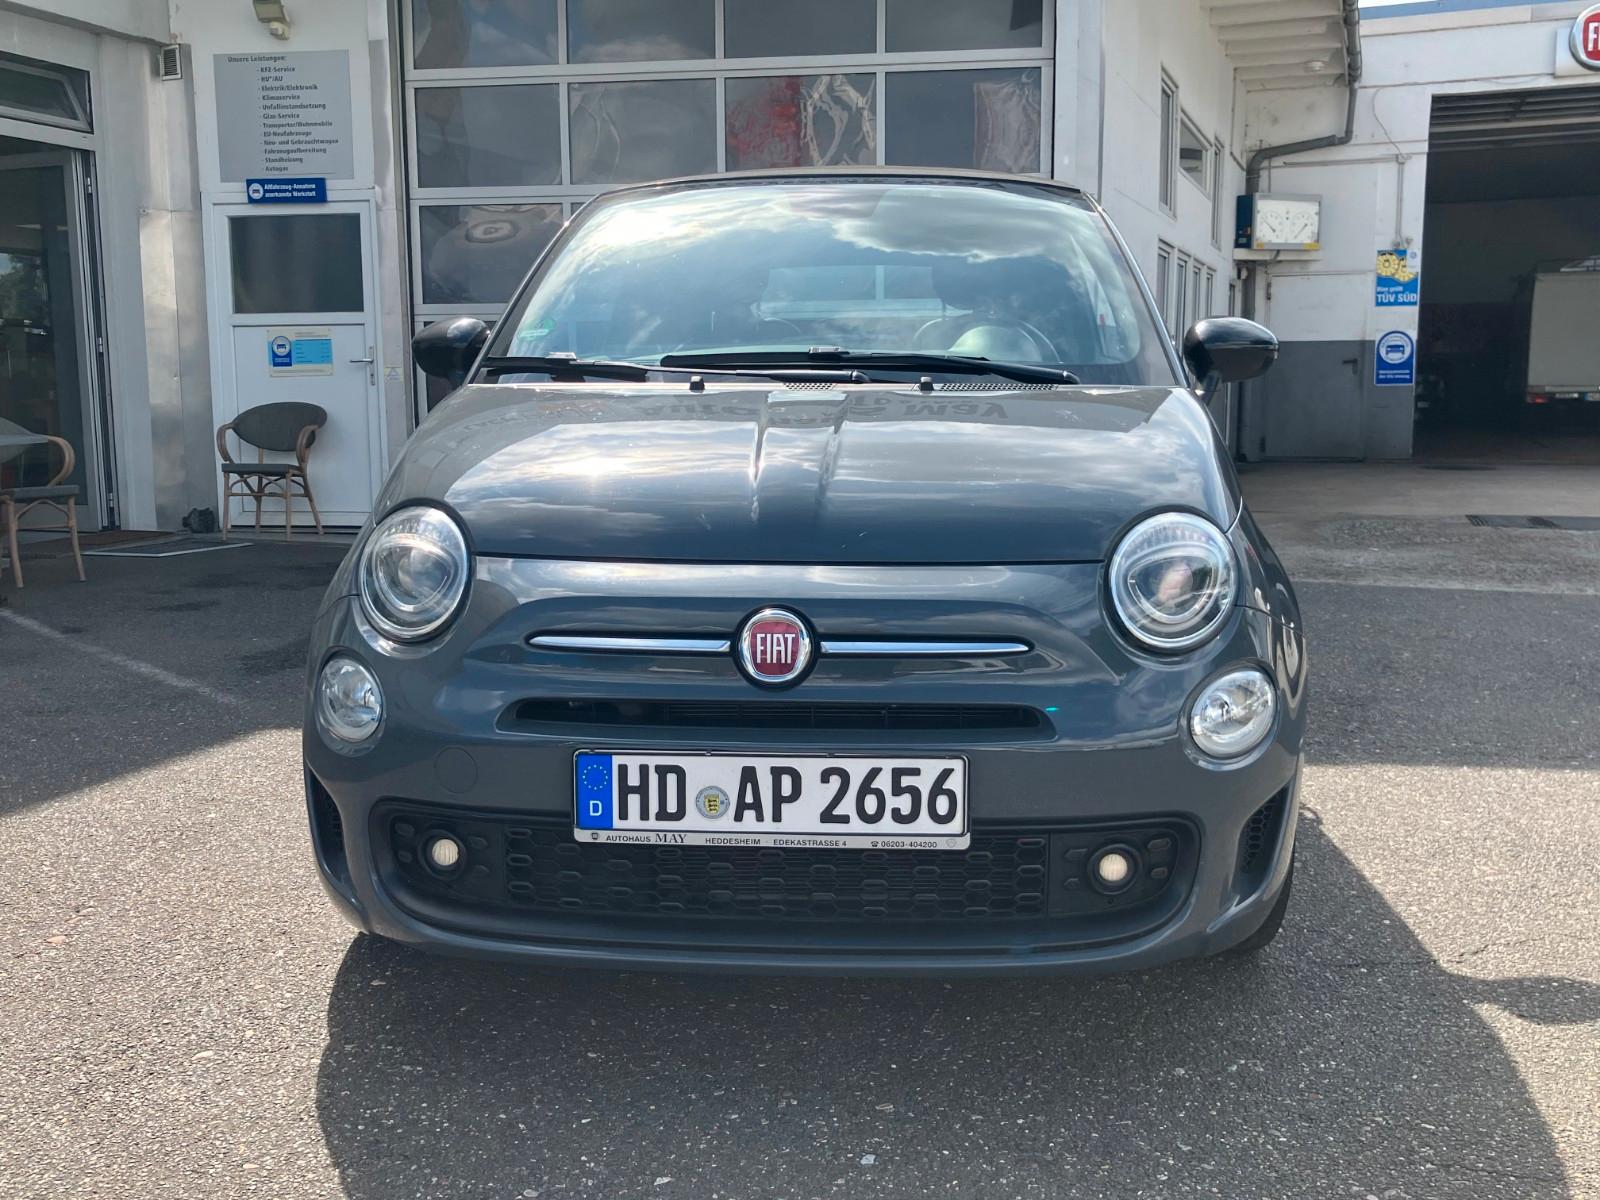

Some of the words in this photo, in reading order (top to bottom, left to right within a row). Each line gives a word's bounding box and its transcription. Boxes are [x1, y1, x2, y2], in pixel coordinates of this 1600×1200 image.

[261, 84, 318, 92] Elektrik/Elektronik
[262, 103, 327, 111] Unfallinstandsetzung
[264, 147, 327, 155] Fahrzeugaufbereitung
[1376, 292, 1396, 303] TÜV
[1397, 291, 1417, 303] SÜD
[756, 633, 796, 664] FIAT
[617, 763, 687, 822] HD
[733, 765, 802, 823] AP
[819, 767, 958, 825] 2656
[589, 801, 602, 817] D
[606, 835, 651, 843] AUTOHAUS
[654, 833, 688, 844] MAY
[705, 837, 761, 845] HEDDESHEIM
[773, 839, 840, 847] EDEKASTRASSE
[880, 840, 938, 848] 06203-404200
